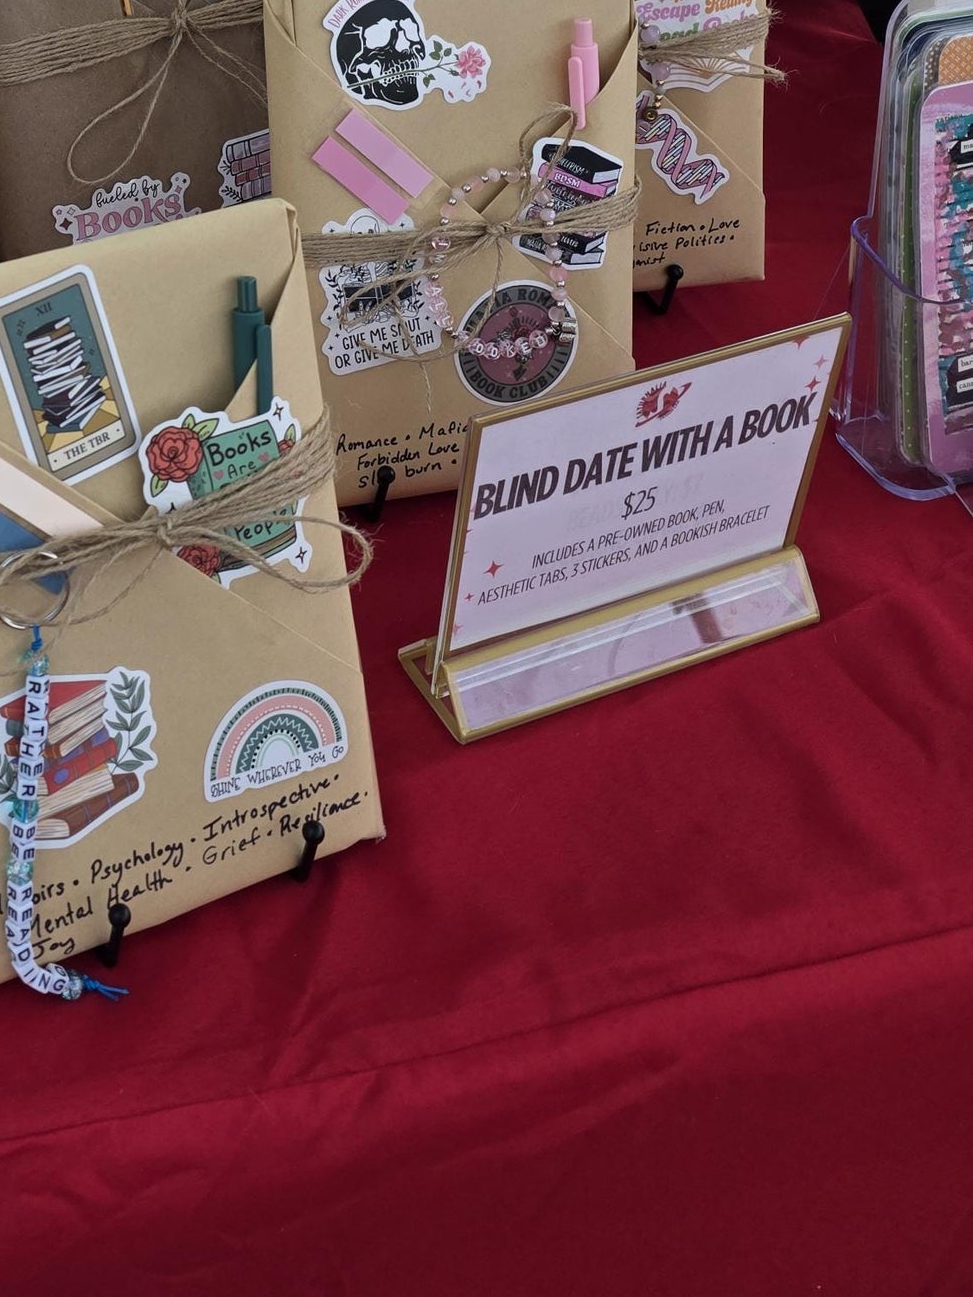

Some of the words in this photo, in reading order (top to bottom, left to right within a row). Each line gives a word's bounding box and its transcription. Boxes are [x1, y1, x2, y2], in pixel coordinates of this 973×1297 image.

[327, 4, 349, 29] DARK
[635, 1, 701, 24] Escape
[95, 181, 140, 209] fueled
[141, 174, 161, 200] by
[553, 172, 581, 189] BDSM
[74, 192, 182, 241] Books
[645, 220, 696, 237] Fiction
[708, 217, 741, 234] Love
[675, 234, 726, 250] Politics
[342, 331, 366, 351] GIVE
[370, 325, 388, 344] ME
[334, 354, 352, 370] OR
[381, 339, 400, 355] ME
[508, 374, 550, 400] CLUB
[63, 440, 89, 461] THE
[88, 430, 112, 451] TBR
[206, 430, 272, 467] Books
[336, 433, 398, 456] Romance
[357, 448, 421, 471] Forbidden
[428, 441, 460, 456] Love
[473, 466, 560, 522] BLIND
[562, 441, 638, 495] DATE
[640, 421, 715, 473] WITH
[713, 414, 738, 454] A
[737, 390, 819, 445] BOOK
[227, 460, 258, 480] Are
[404, 462, 442, 478] burn
[620, 485, 658, 521] $25
[532, 541, 585, 570] INCLUDES
[586, 538, 595, 555] A
[598, 516, 666, 551] PRE-OWNED
[666, 507, 699, 535] BOOK,
[701, 499, 726, 523] PEN,
[477, 575, 537, 606] AESTHETIC
[539, 565, 569, 588] TABS,
[570, 562, 580, 578] 3
[579, 547, 631, 578] STICKERS,
[634, 538, 659, 557] AND
[659, 536, 670, 550] A
[670, 523, 719, 548] BOOKISH
[717, 504, 771, 533] BRACELET
[18, 678, 50, 797] RATHER
[211, 776, 242, 798] SHINE
[246, 757, 303, 786] WHEREVER
[307, 751, 327, 768] YOU
[11, 823, 36, 861] BE
[89, 837, 185, 894] Psychology
[202, 779, 332, 842] Introspective
[107, 868, 173, 909] Health
[202, 826, 262, 866] Grief
[5, 885, 68, 993] READING
[31, 936, 77, 961] Joy
